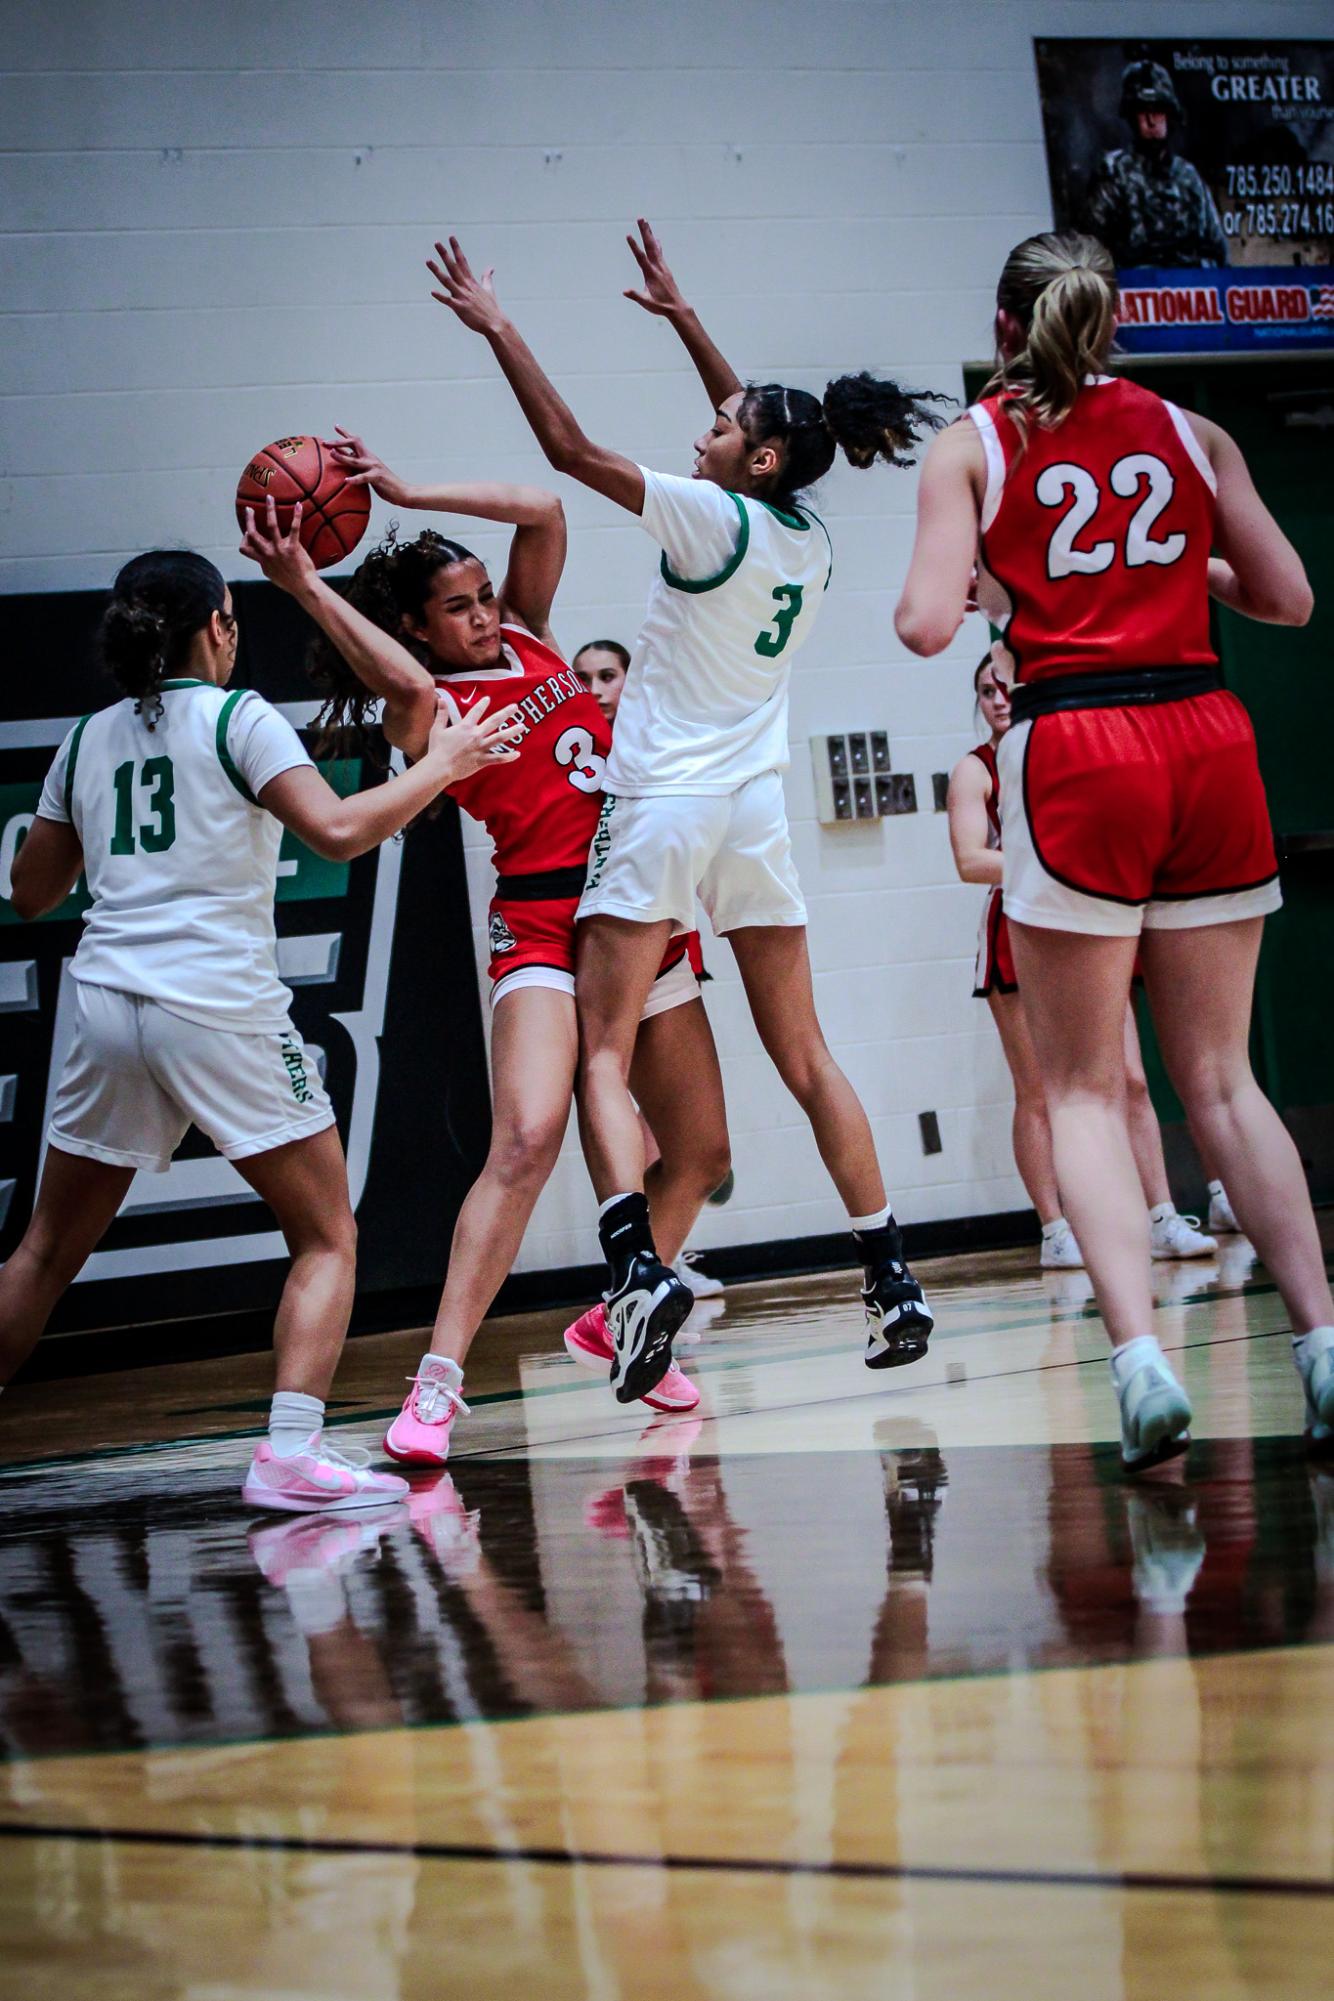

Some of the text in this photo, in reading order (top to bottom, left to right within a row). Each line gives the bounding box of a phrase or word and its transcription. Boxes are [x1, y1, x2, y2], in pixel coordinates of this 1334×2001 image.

[1173, 51, 1290, 75] Belong to something
[1211, 75, 1321, 101] GREATER
[1226, 164, 1334, 196] 785.250.1484
[1223, 202, 1334, 235] or 785.274.16
[1117, 285, 1310, 327] ATIONAL GUARD
[1036, 453, 1187, 582] 22
[754, 583, 804, 658] 3
[553, 725, 607, 794] 3
[110, 755, 176, 855] 13
[279, 1032, 314, 1103] THERS
